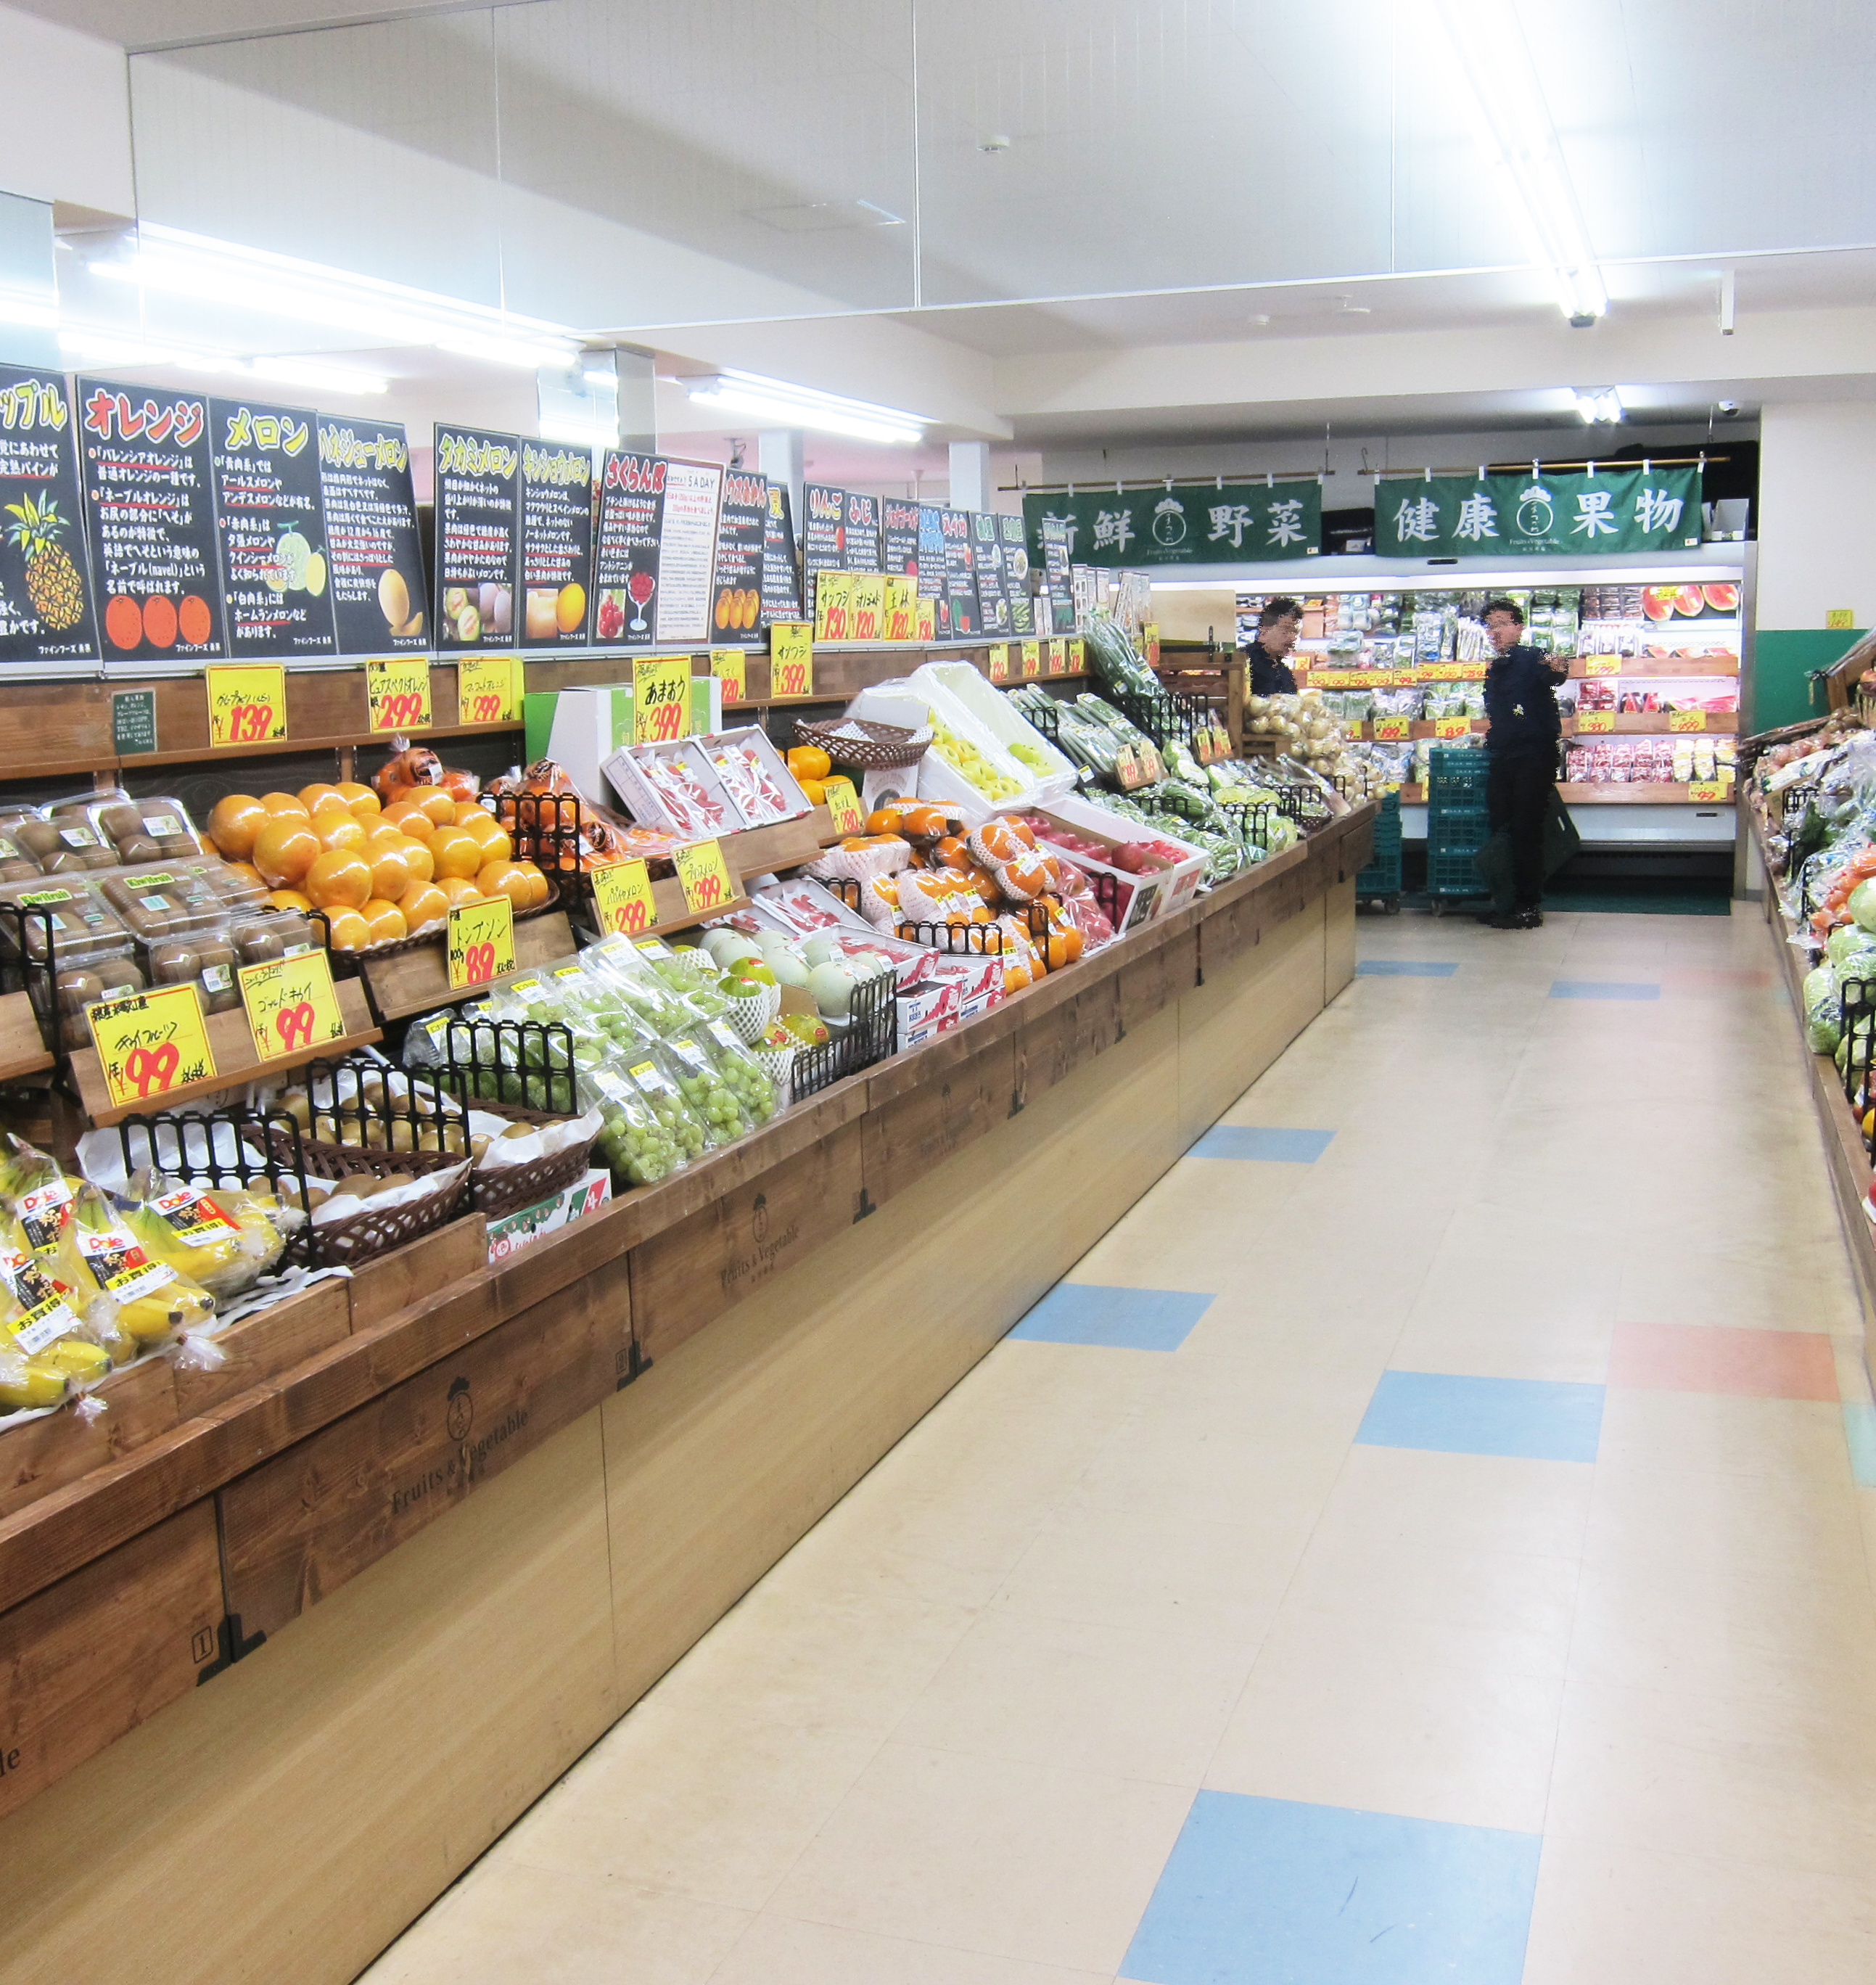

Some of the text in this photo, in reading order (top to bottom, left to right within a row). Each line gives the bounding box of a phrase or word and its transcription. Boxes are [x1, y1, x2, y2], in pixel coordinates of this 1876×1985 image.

[85, 388, 204, 448] オレンジ
[226, 407, 308, 457] メロン
[439, 433, 517, 480] タカミメロン
[699, 477, 715, 489] DAY
[1207, 499, 1307, 547] 野菜
[1392, 492, 1501, 542] 健康
[1571, 488, 1684, 538] 果物
[782, 664, 805, 694] 399
[230, 704, 273, 740] 139
[379, 693, 422, 728] 299
[473, 694, 501, 721] 299
[650, 702, 682, 742] 399
[694, 874, 721, 909] 399
[456, 918, 508, 947] トンプソン
[615, 899, 646, 933] 299
[466, 942, 495, 985] 89
[276, 1002, 316, 1051] 99
[126, 1041, 180, 1098] 99
[24, 1189, 59, 1210] Dole
[159, 1191, 192, 1210] Dole
[90, 1236, 123, 1249] Dole
[760, 1225, 799, 1262] Vegetable
[392, 1467, 443, 1515] Fruits
[458, 1410, 528, 1471] Vegetable
